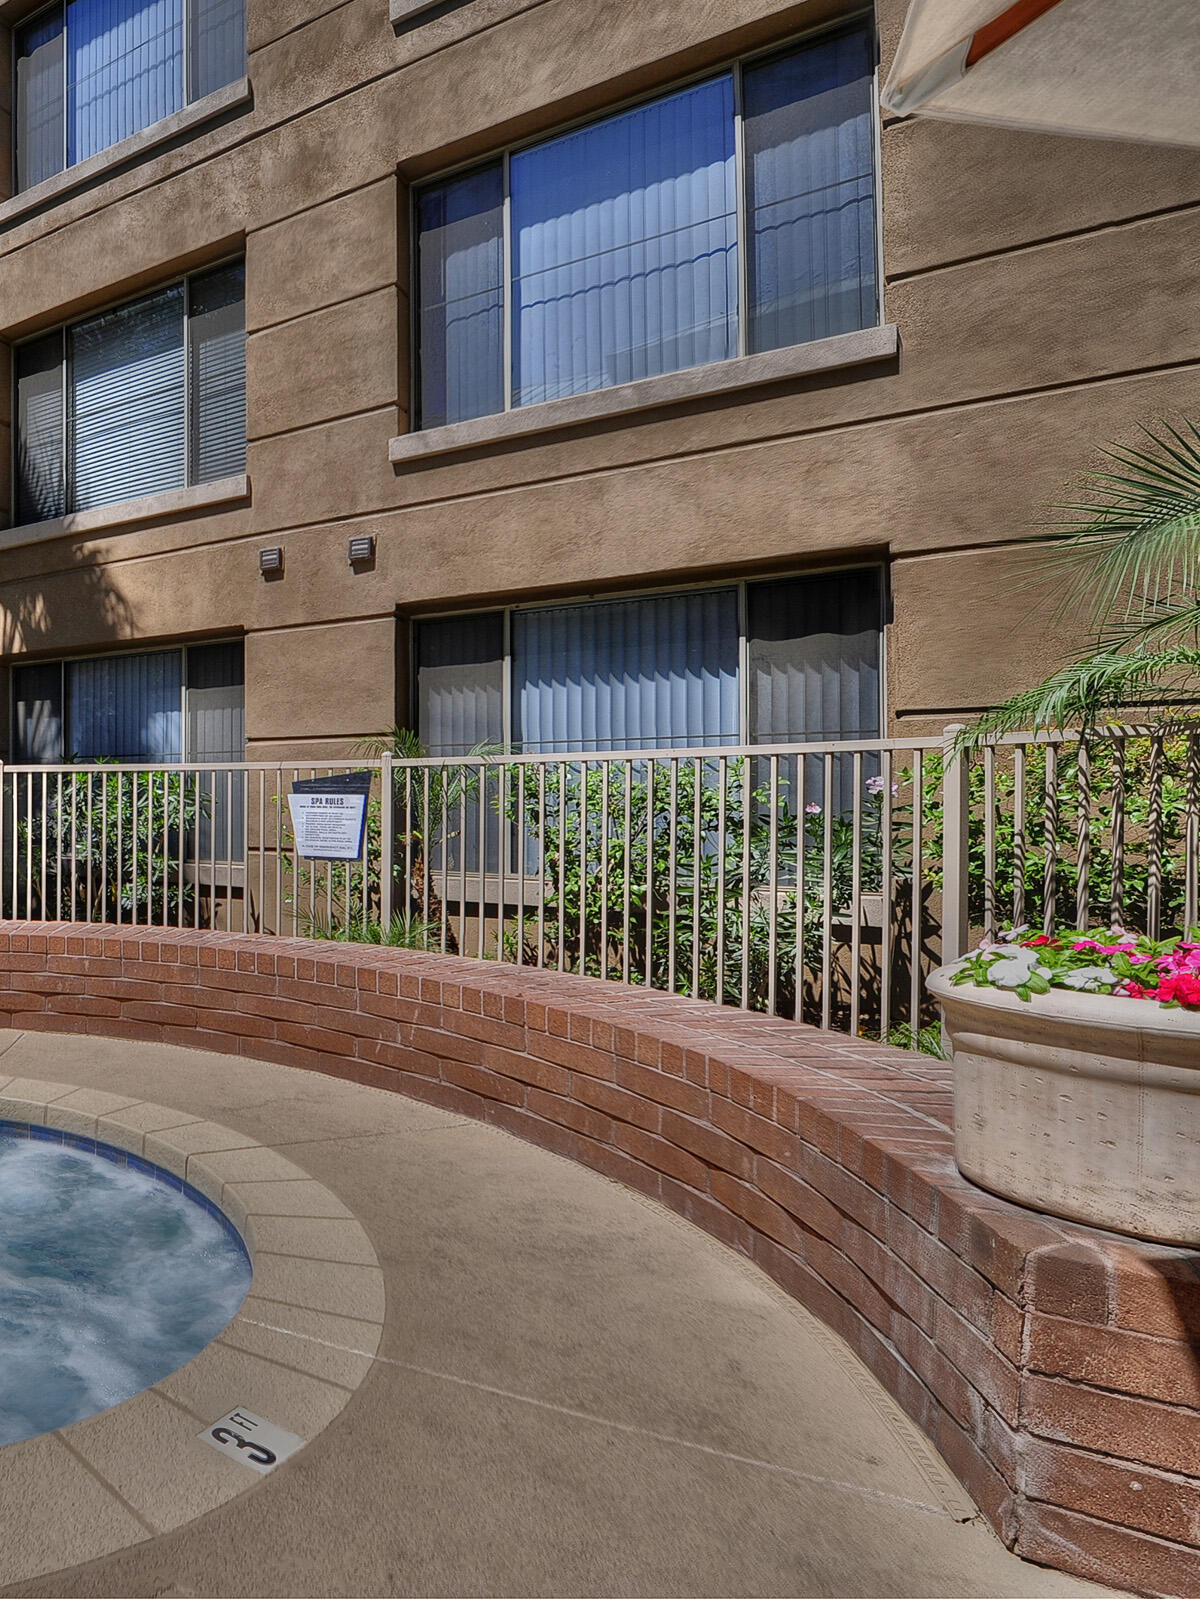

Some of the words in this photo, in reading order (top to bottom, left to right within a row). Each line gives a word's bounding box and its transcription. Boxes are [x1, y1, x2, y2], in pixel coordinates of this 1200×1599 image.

[311, 797, 323, 805] SPA
[325, 797, 344, 805] RULES
[229, 1412, 259, 1432] FT
[211, 1427, 277, 1466] 3
